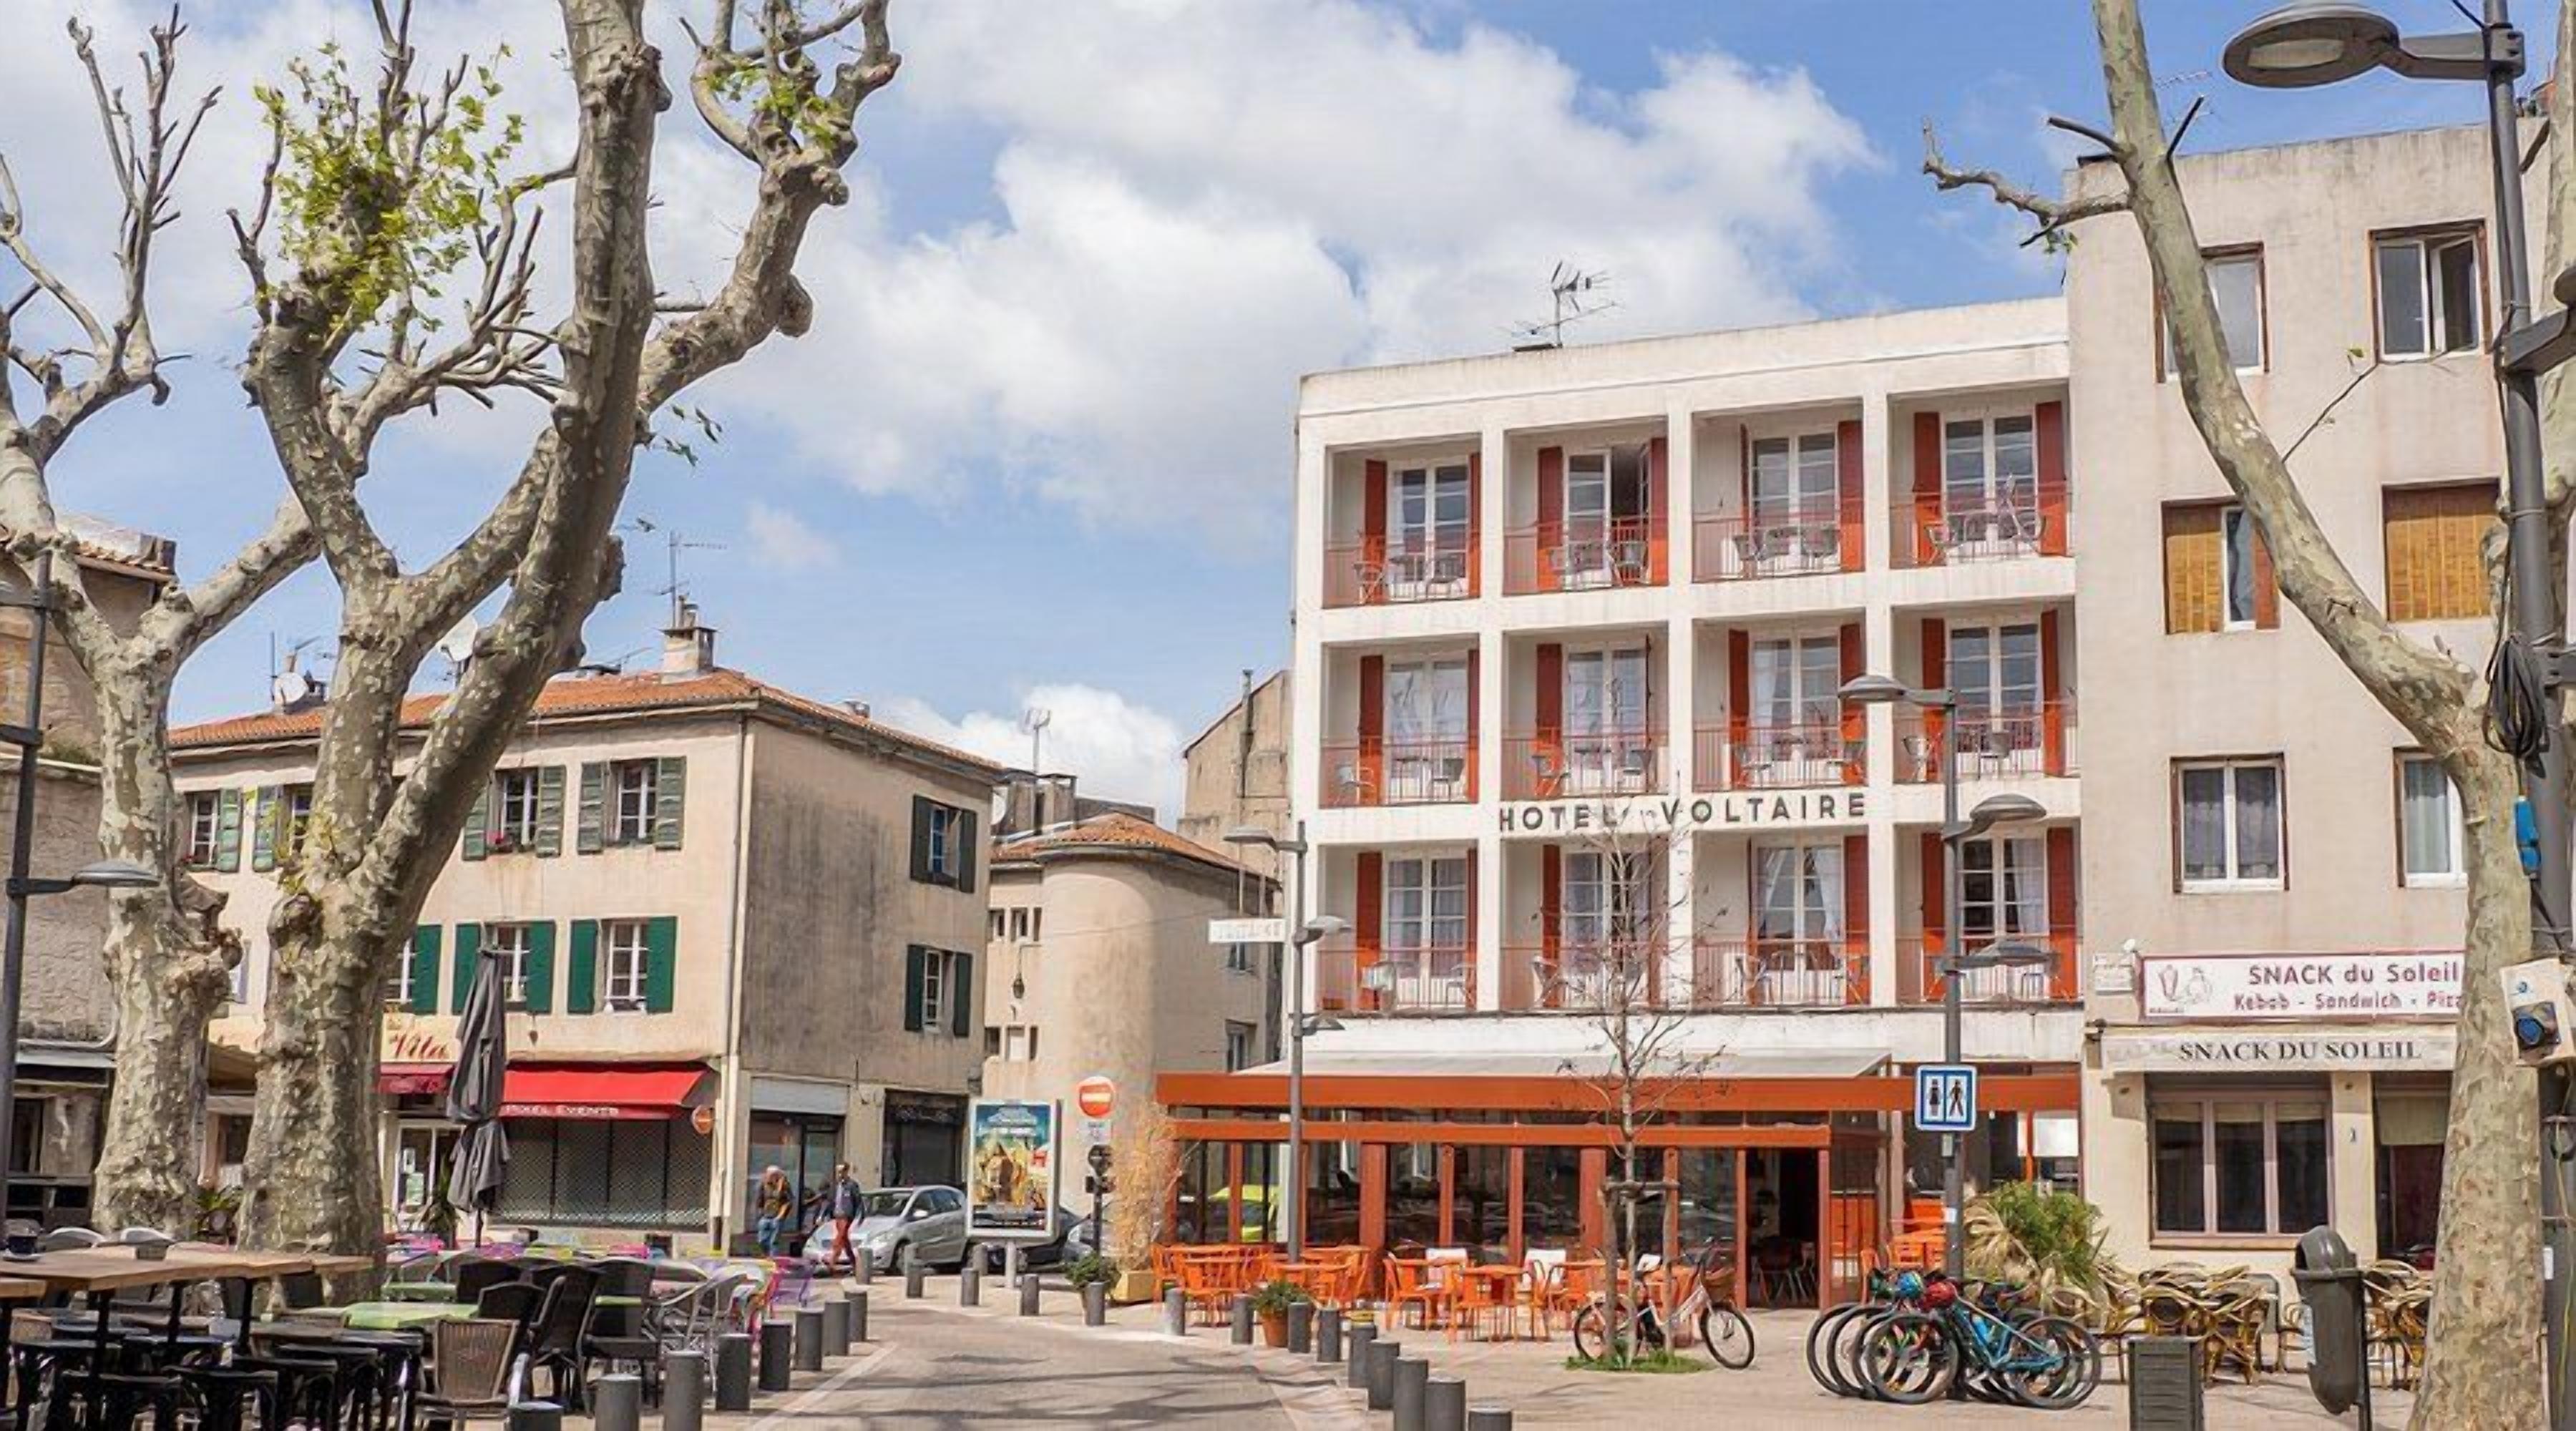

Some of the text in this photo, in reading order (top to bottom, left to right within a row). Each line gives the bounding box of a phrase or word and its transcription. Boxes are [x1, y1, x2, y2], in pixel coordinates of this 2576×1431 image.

[1499, 792, 1865, 832] HOTEL VOLTAIRE
[2248, 961, 2458, 985] SNACK du Soleil
[2316, 992, 2401, 1010] Sandwich
[2181, 1042, 2270, 1060] SNACK
[2278, 1041, 2318, 1060] DU
[2326, 1041, 2422, 1059] SOLEIL
